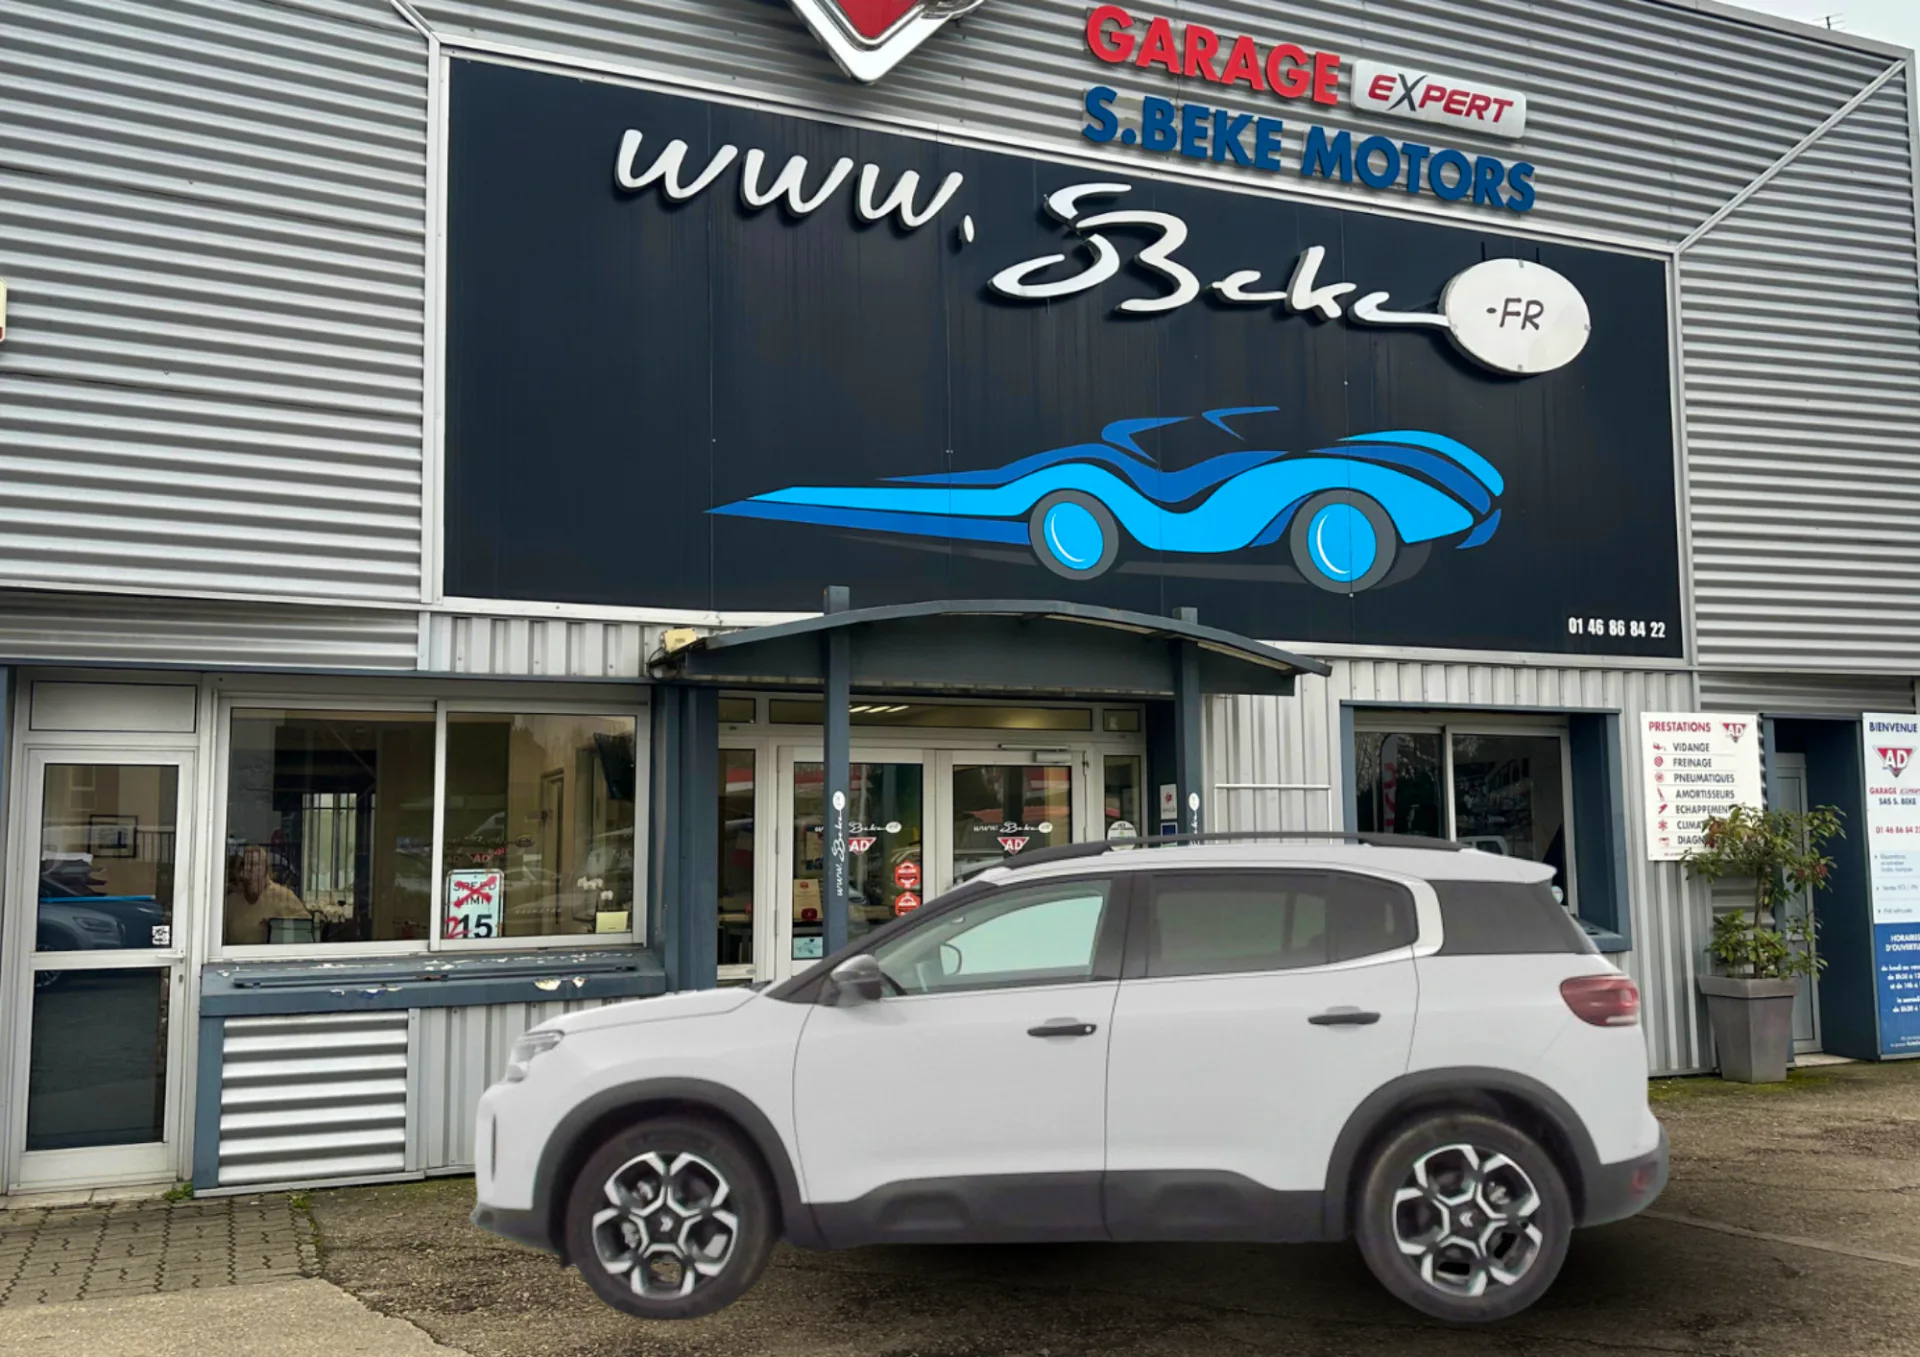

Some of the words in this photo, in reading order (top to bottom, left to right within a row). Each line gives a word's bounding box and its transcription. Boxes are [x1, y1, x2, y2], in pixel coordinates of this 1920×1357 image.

[1086, 6, 1341, 105] GARAGE
[1368, 73, 1514, 123] EXPERT
[1083, 86, 1283, 171] S.BEKE
[1301, 126, 1536, 212] MOTORS
[1568, 617, 1583, 634] 01
[1587, 618, 1604, 636] 46
[1609, 619, 1625, 636] 86
[1630, 620, 1646, 637] 84
[1650, 622, 1666, 638] 22
[1649, 721, 1711, 733] PRESTATIONS
[1869, 722, 1918, 733] BIENVENUE
[1673, 742, 1710, 752] VIDANGE
[1673, 758, 1712, 768] FREINAGE
[1885, 749, 1909, 769] AD
[1674, 773, 1735, 784] PNEUMATIQUES
[1675, 789, 1735, 800] AMORTISSEURS
[1677, 820, 1703, 830] CLIMA
[1004, 839, 1023, 851] AD
[1677, 835, 1706, 845] DIAGN
[849, 841, 870, 852] AD
